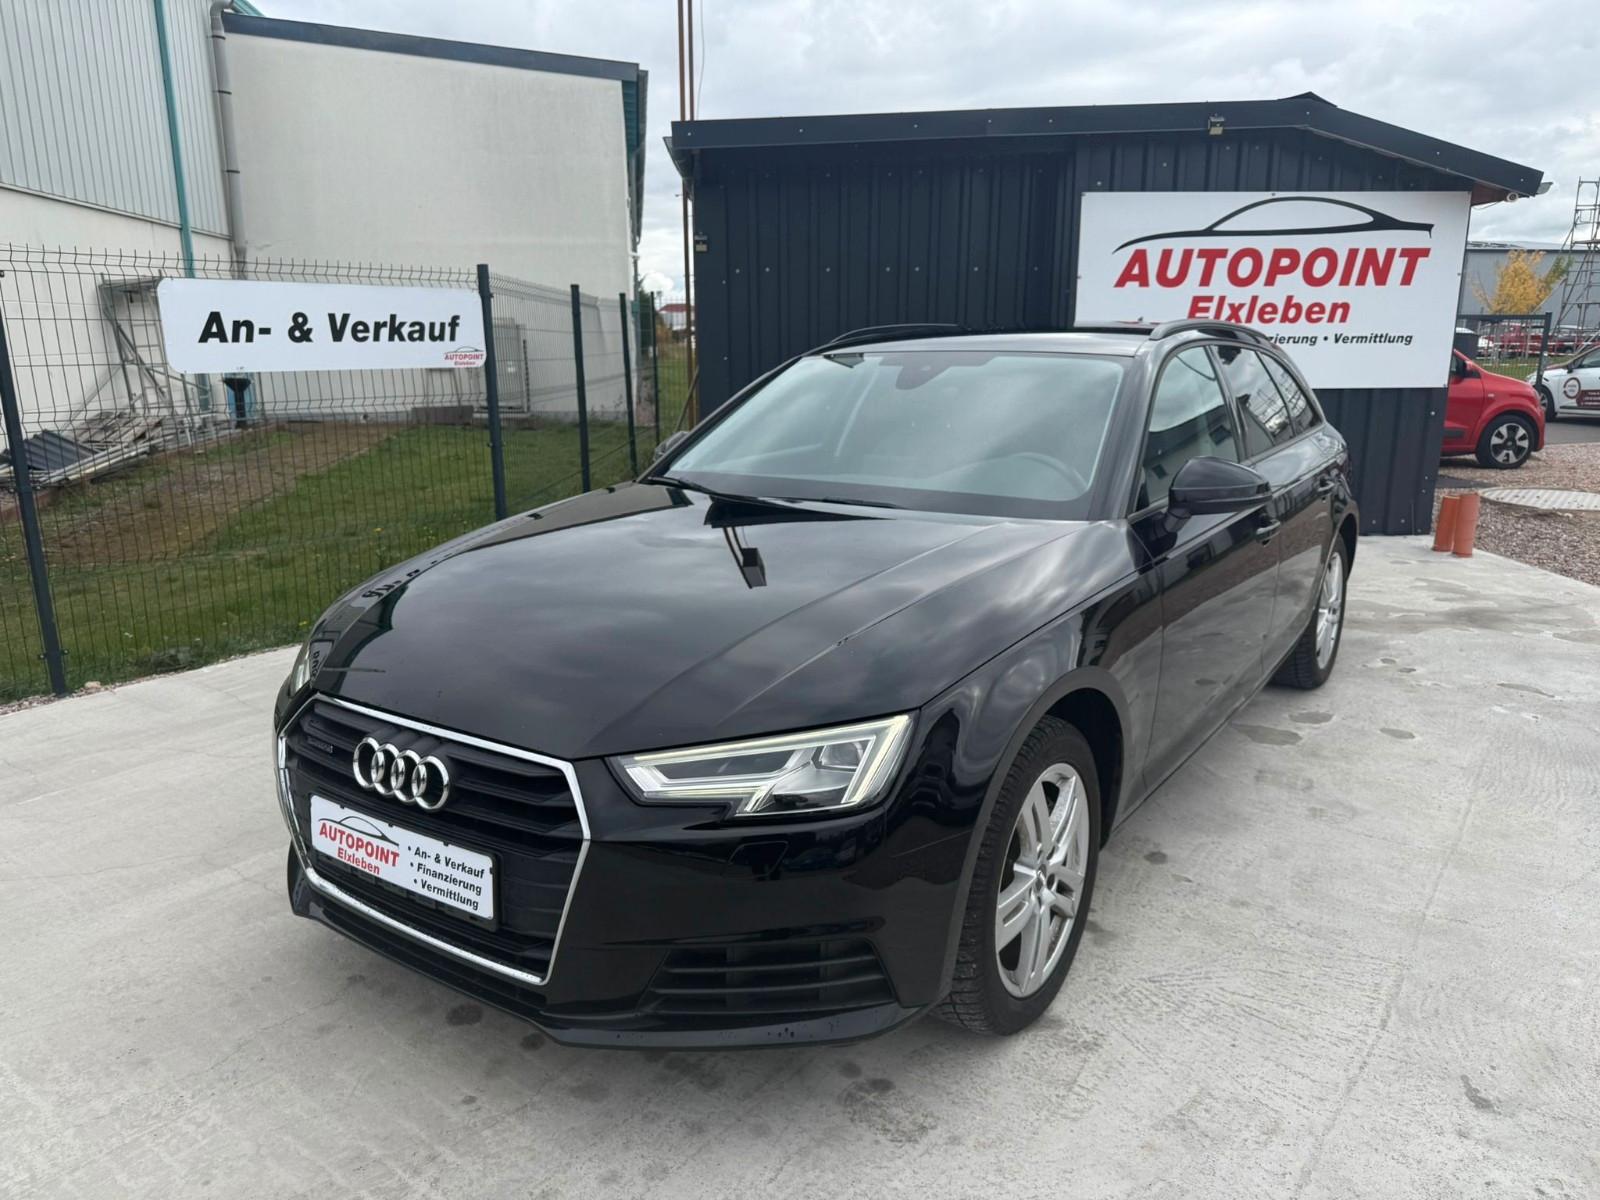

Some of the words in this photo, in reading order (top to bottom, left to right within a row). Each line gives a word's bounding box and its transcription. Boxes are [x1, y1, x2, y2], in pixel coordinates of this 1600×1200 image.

[1113, 247, 1431, 288] AUTOPOINT
[1187, 295, 1351, 324] Elxleben
[198, 311, 272, 344] An-
[288, 312, 313, 343] &
[327, 313, 460, 343] Verkauf
[1334, 333, 1413, 346] Vermittlung
[319, 822, 400, 867] AUTOPOINT
[337, 847, 380, 875] Elxleben
[414, 846, 431, 860] An-
[434, 853, 442, 864] &
[444, 856, 485, 879] Verkauf
[417, 862, 482, 896] Finanzierung
[421, 879, 479, 911] Vermittlung
